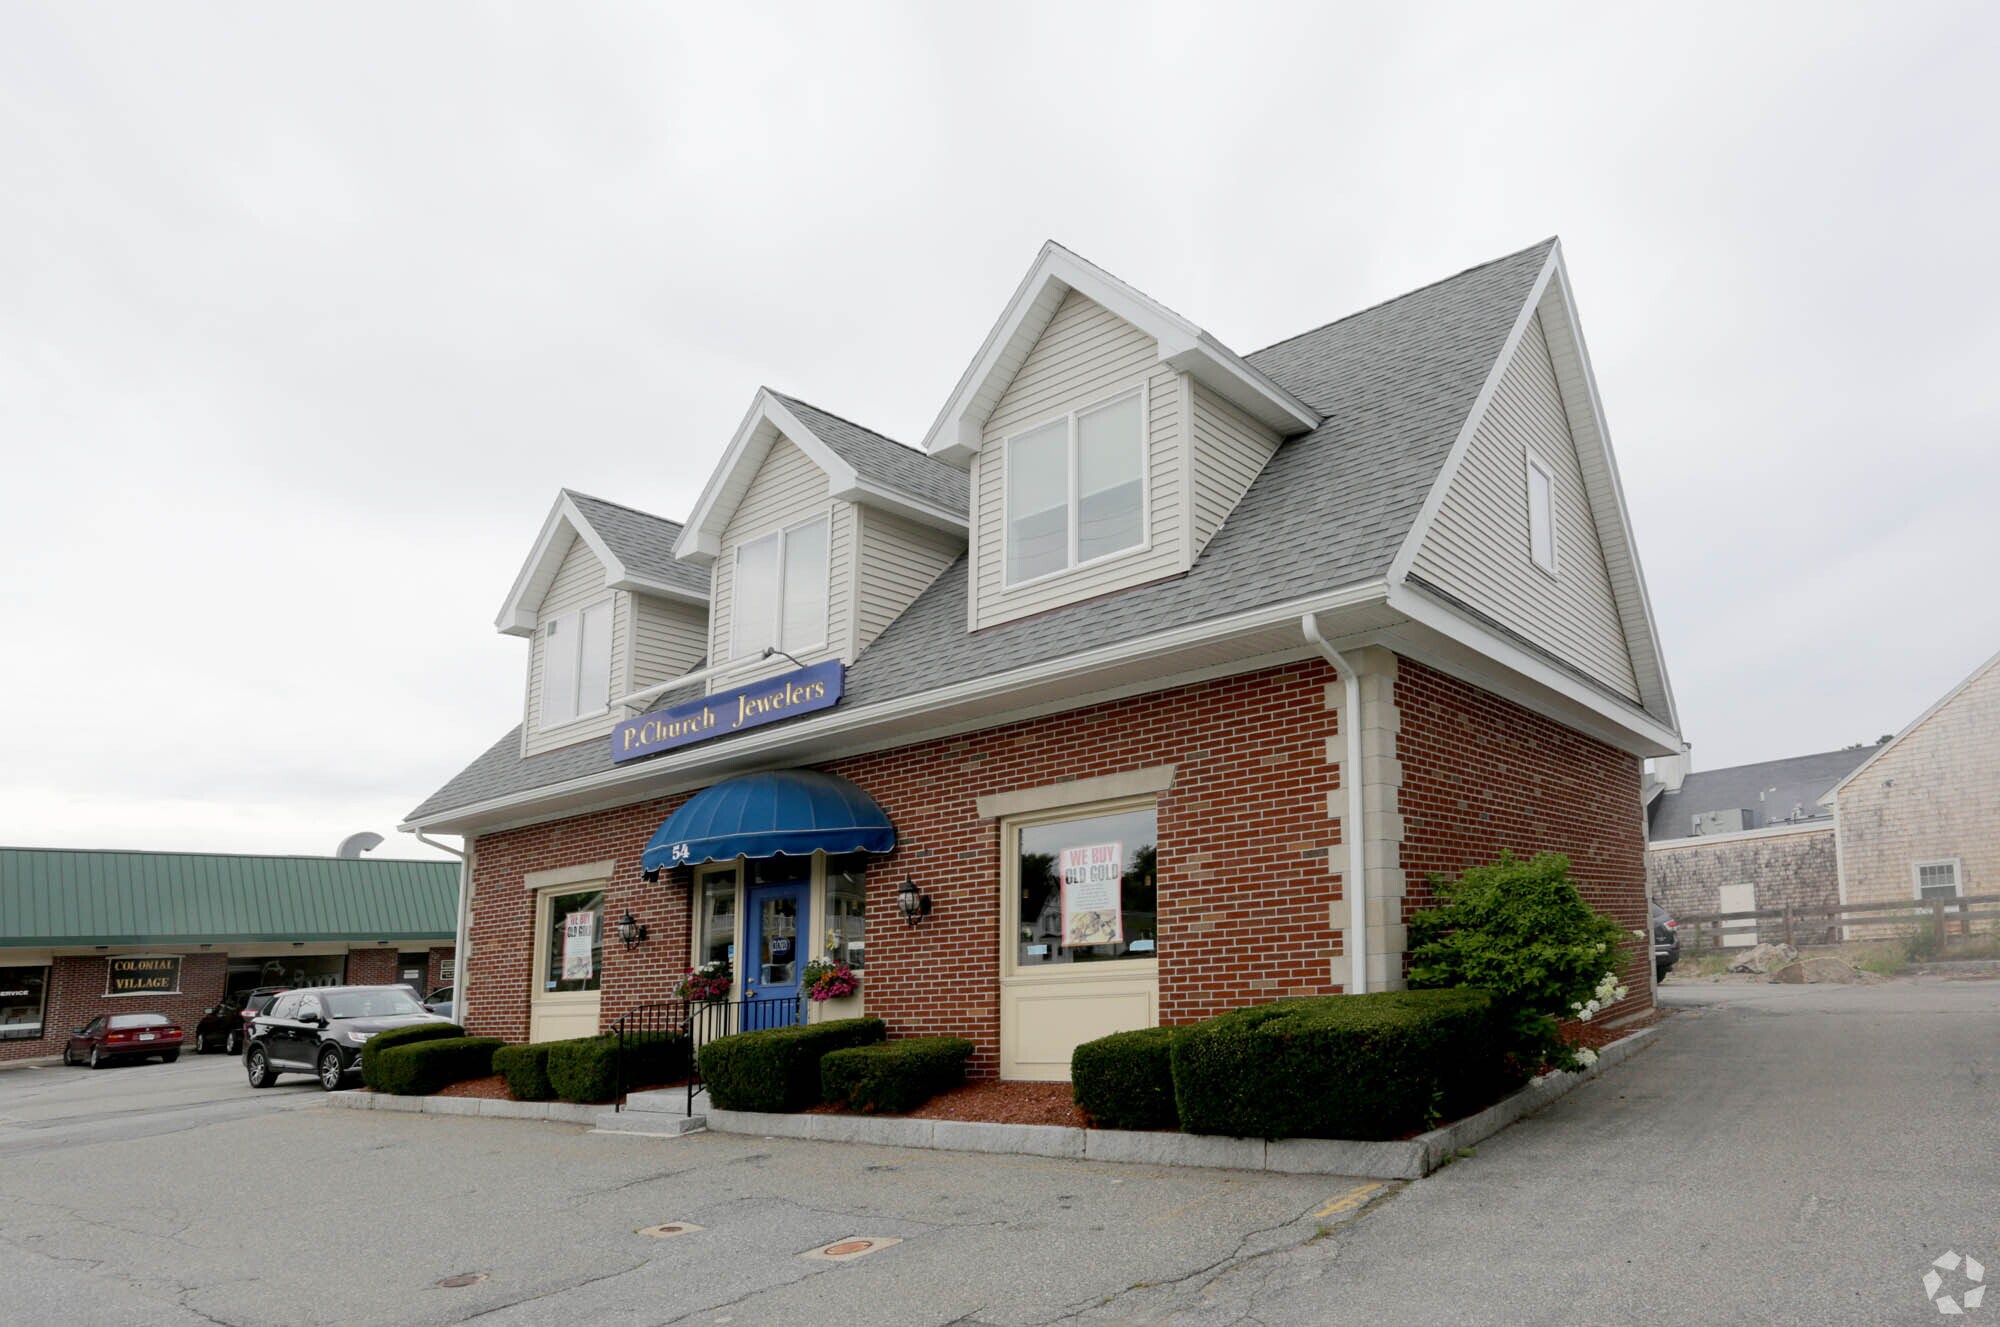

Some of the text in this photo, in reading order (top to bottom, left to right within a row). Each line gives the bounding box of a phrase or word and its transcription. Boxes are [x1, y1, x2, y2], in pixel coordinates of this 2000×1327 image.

[732, 680, 825, 728] Jewelers
[672, 844, 690, 859] 54
[1069, 847, 1114, 866] WE BUY
[1065, 864, 1118, 885] OLD GOLD
[114, 959, 174, 971] COLONIAL
[116, 977, 169, 989] VILLAGE
